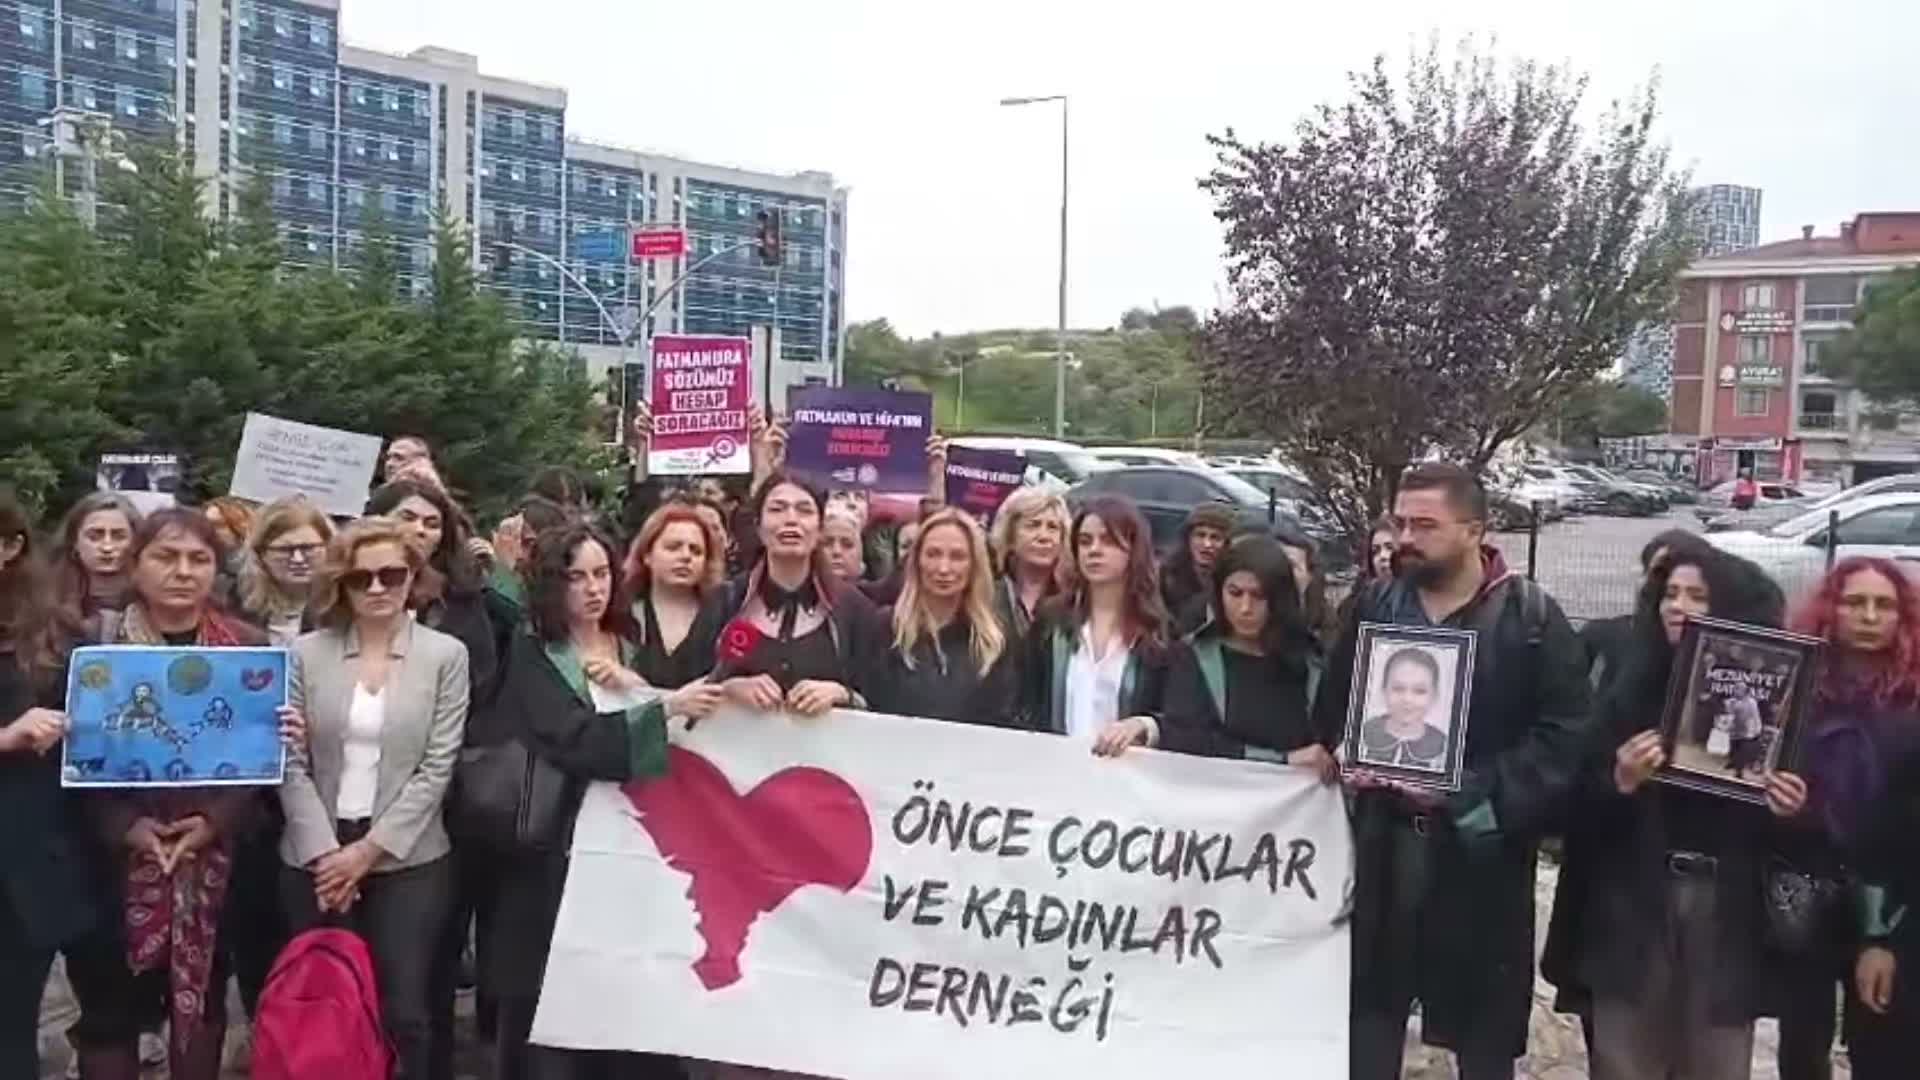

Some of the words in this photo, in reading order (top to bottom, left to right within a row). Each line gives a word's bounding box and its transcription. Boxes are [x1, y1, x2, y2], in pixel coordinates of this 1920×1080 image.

[675, 391, 725, 410] HESAP
[892, 780, 1034, 858] ÖNCE
[1048, 817, 1317, 899] ÇOCUKLAR
[882, 875, 948, 926] VE
[962, 884, 1223, 968] KADINLAR
[868, 955, 1114, 1041] DERNEĞİ
